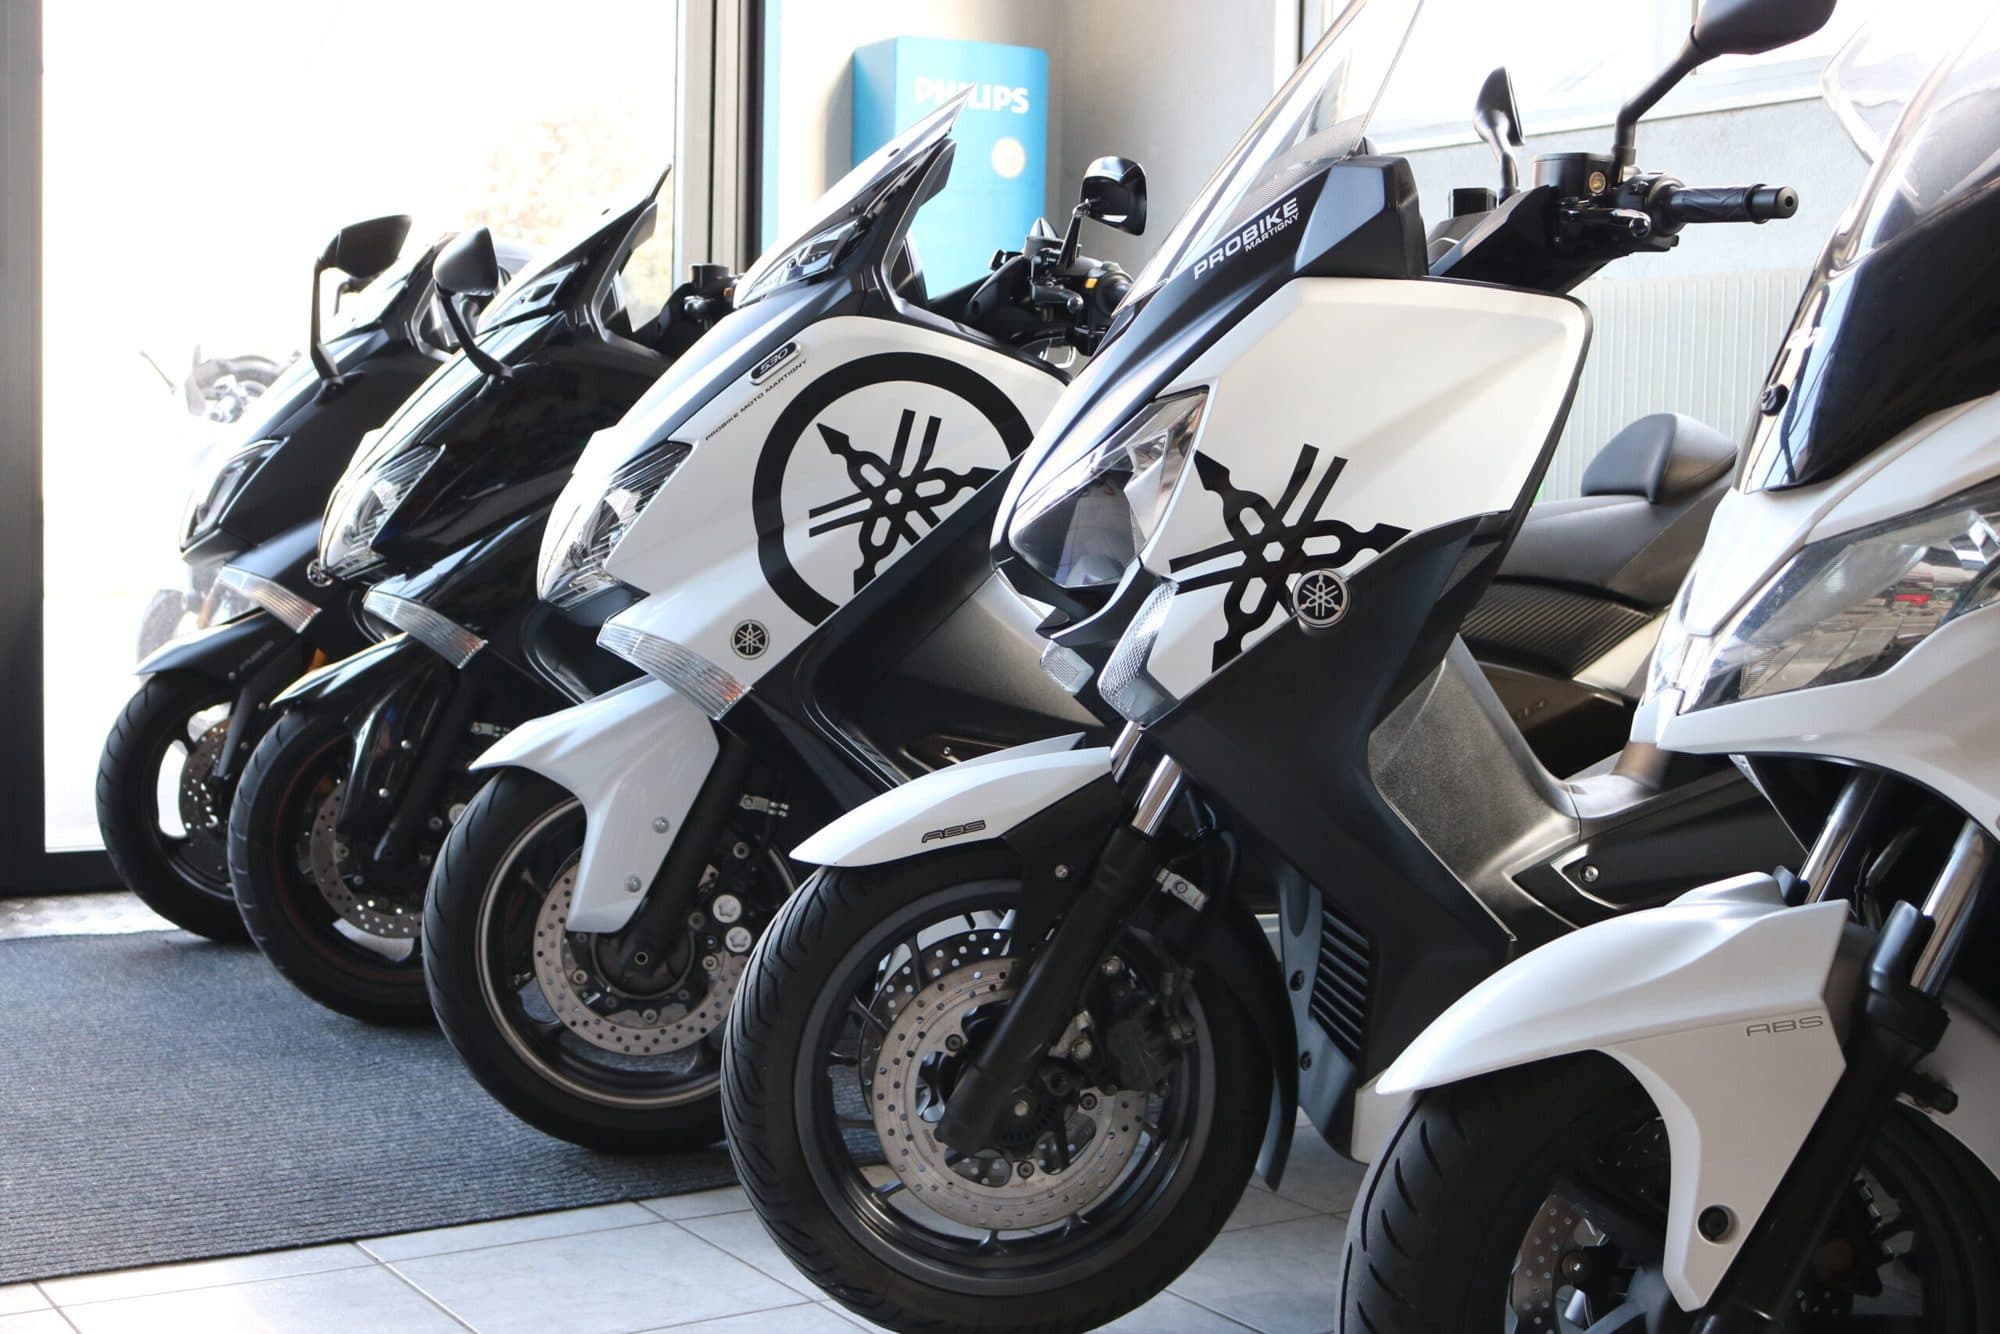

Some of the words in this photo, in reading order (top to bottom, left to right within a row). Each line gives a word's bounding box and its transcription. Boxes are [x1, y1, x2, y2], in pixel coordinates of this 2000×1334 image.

[1193, 197, 1299, 280] PROBIKE
[1244, 212, 1299, 252] MARTIGNY
[705, 412, 739, 440] PROBIKE
[740, 392, 764, 413] MOTO
[921, 819, 986, 844] ABS
[1746, 1015, 1824, 1037] ABS
